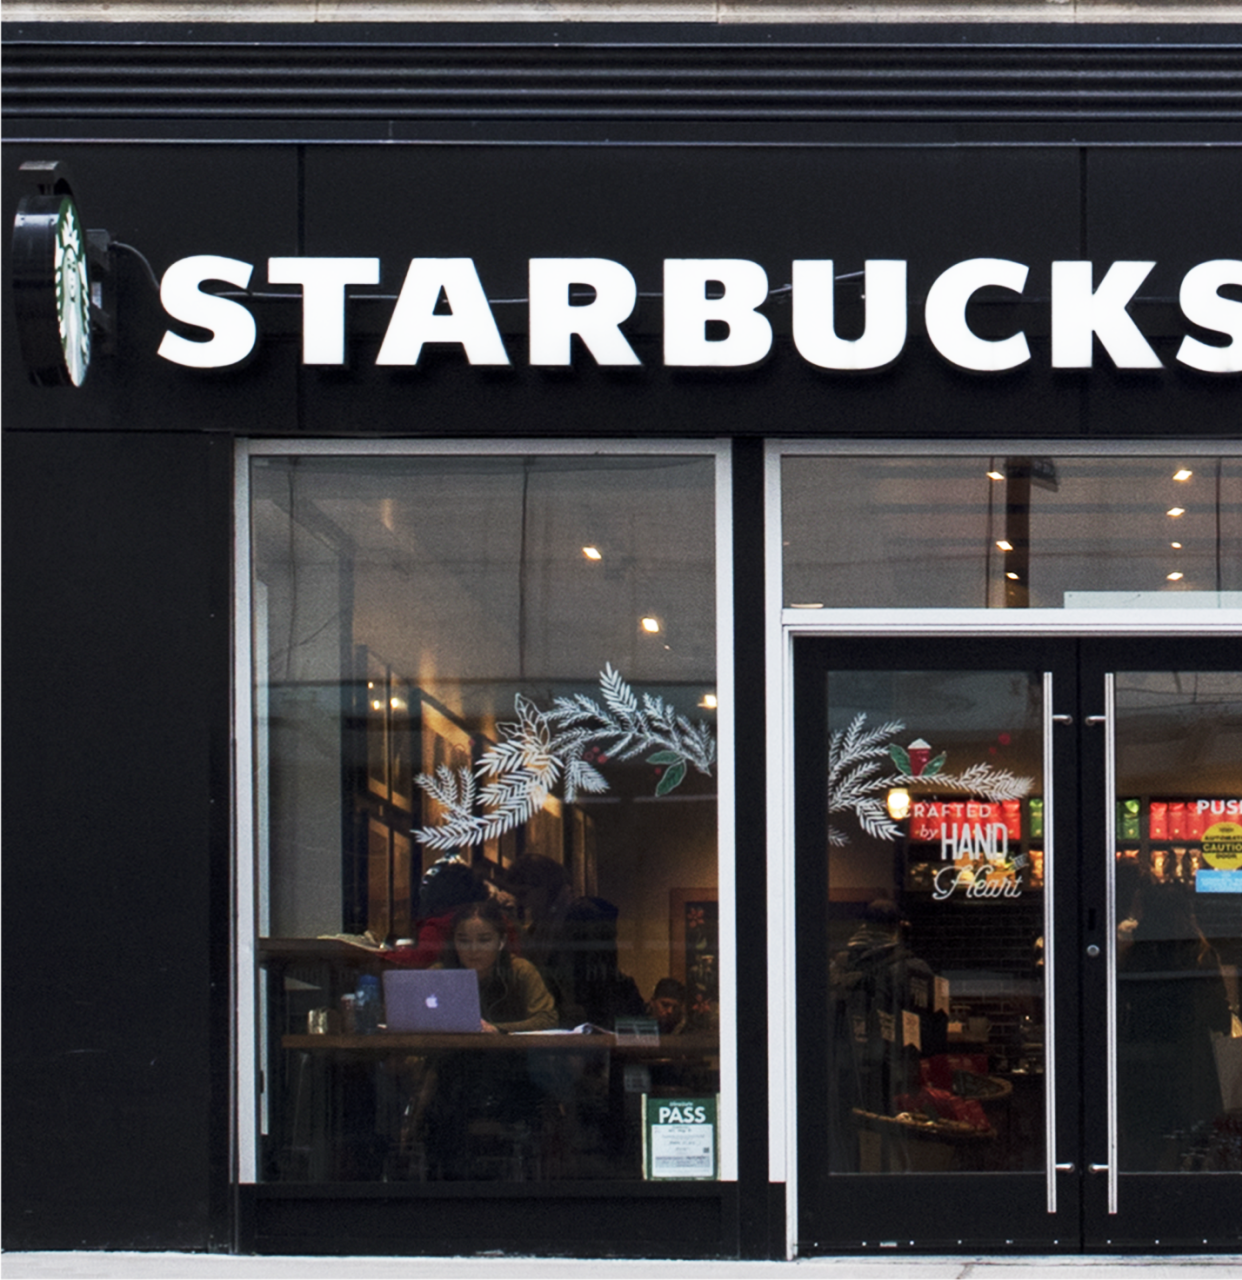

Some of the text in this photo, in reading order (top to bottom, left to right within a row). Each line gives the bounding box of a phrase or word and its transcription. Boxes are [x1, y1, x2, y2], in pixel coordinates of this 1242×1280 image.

[900, 804, 991, 818] CRAFTED
[920, 822, 1008, 860] by HAND
[932, 864, 1023, 900] Heart
[659, 1106, 706, 1124] PASS
